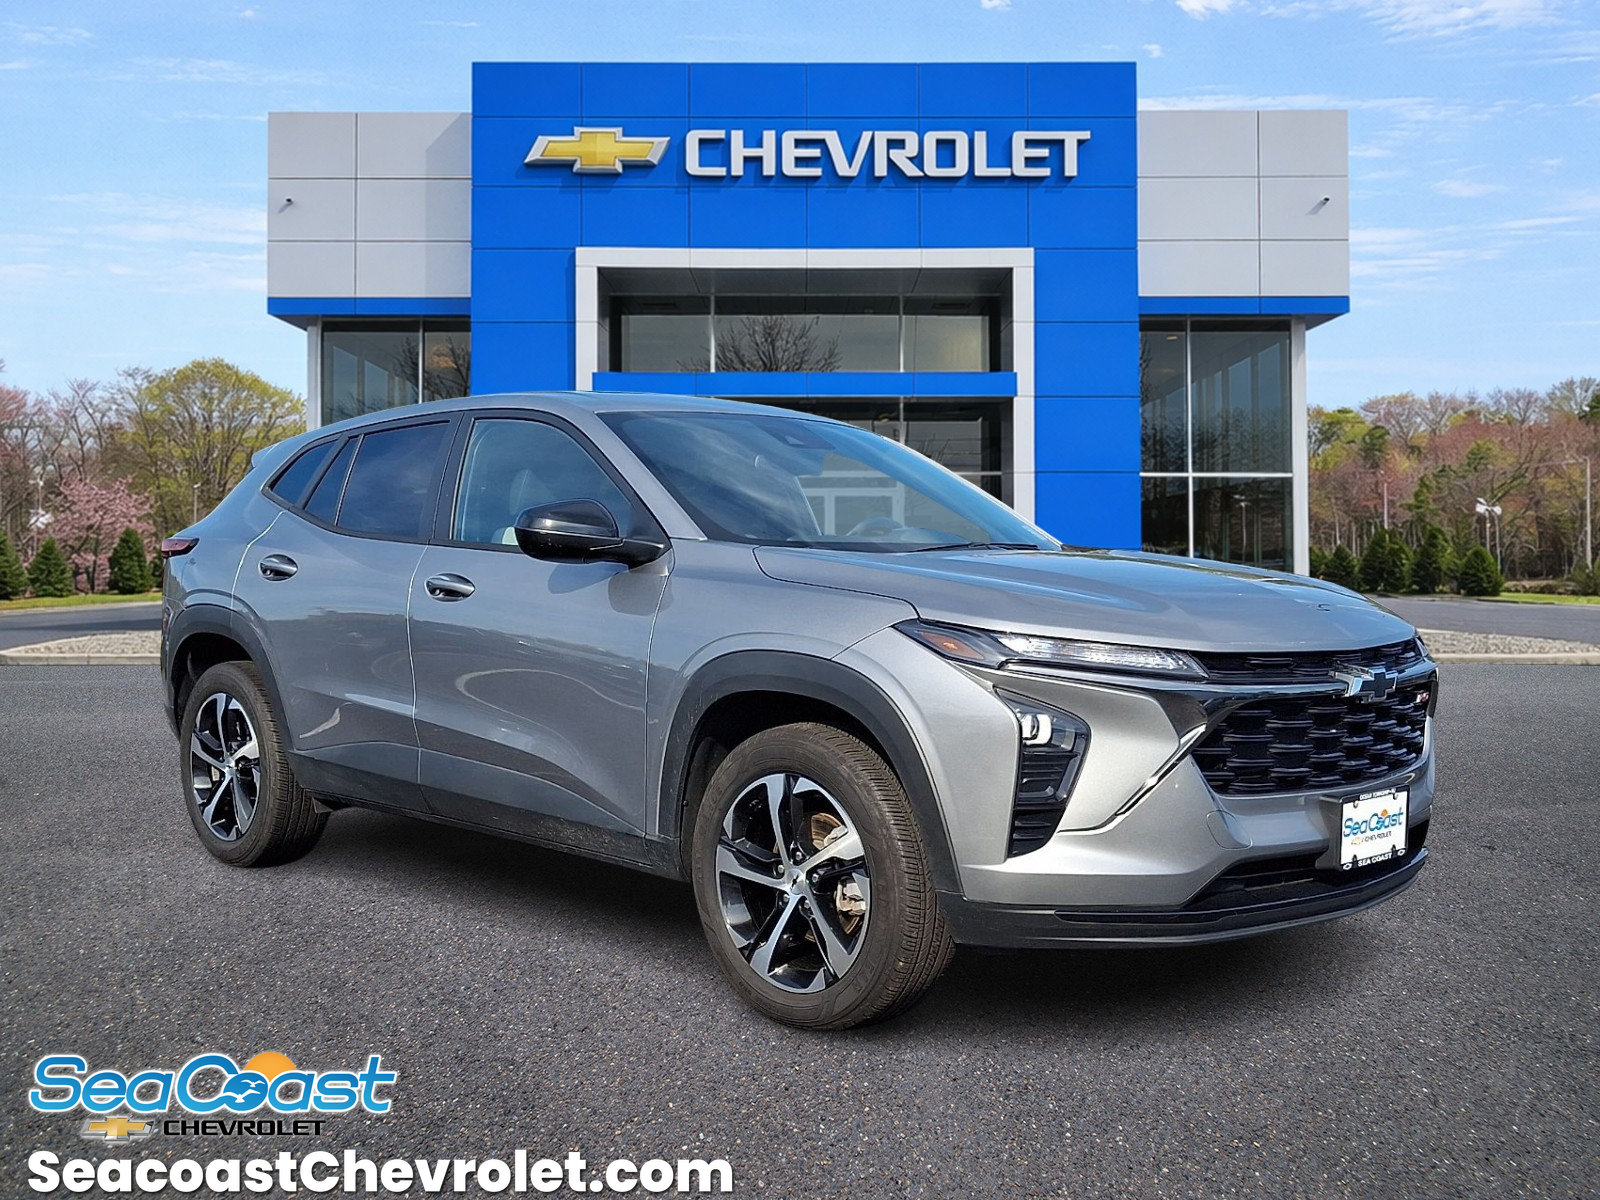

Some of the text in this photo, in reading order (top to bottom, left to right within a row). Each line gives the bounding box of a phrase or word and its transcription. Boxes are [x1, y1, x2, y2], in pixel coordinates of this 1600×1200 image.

[685, 130, 1091, 178] CHEVROLET
[1358, 852, 1392, 867] SEA COAST
